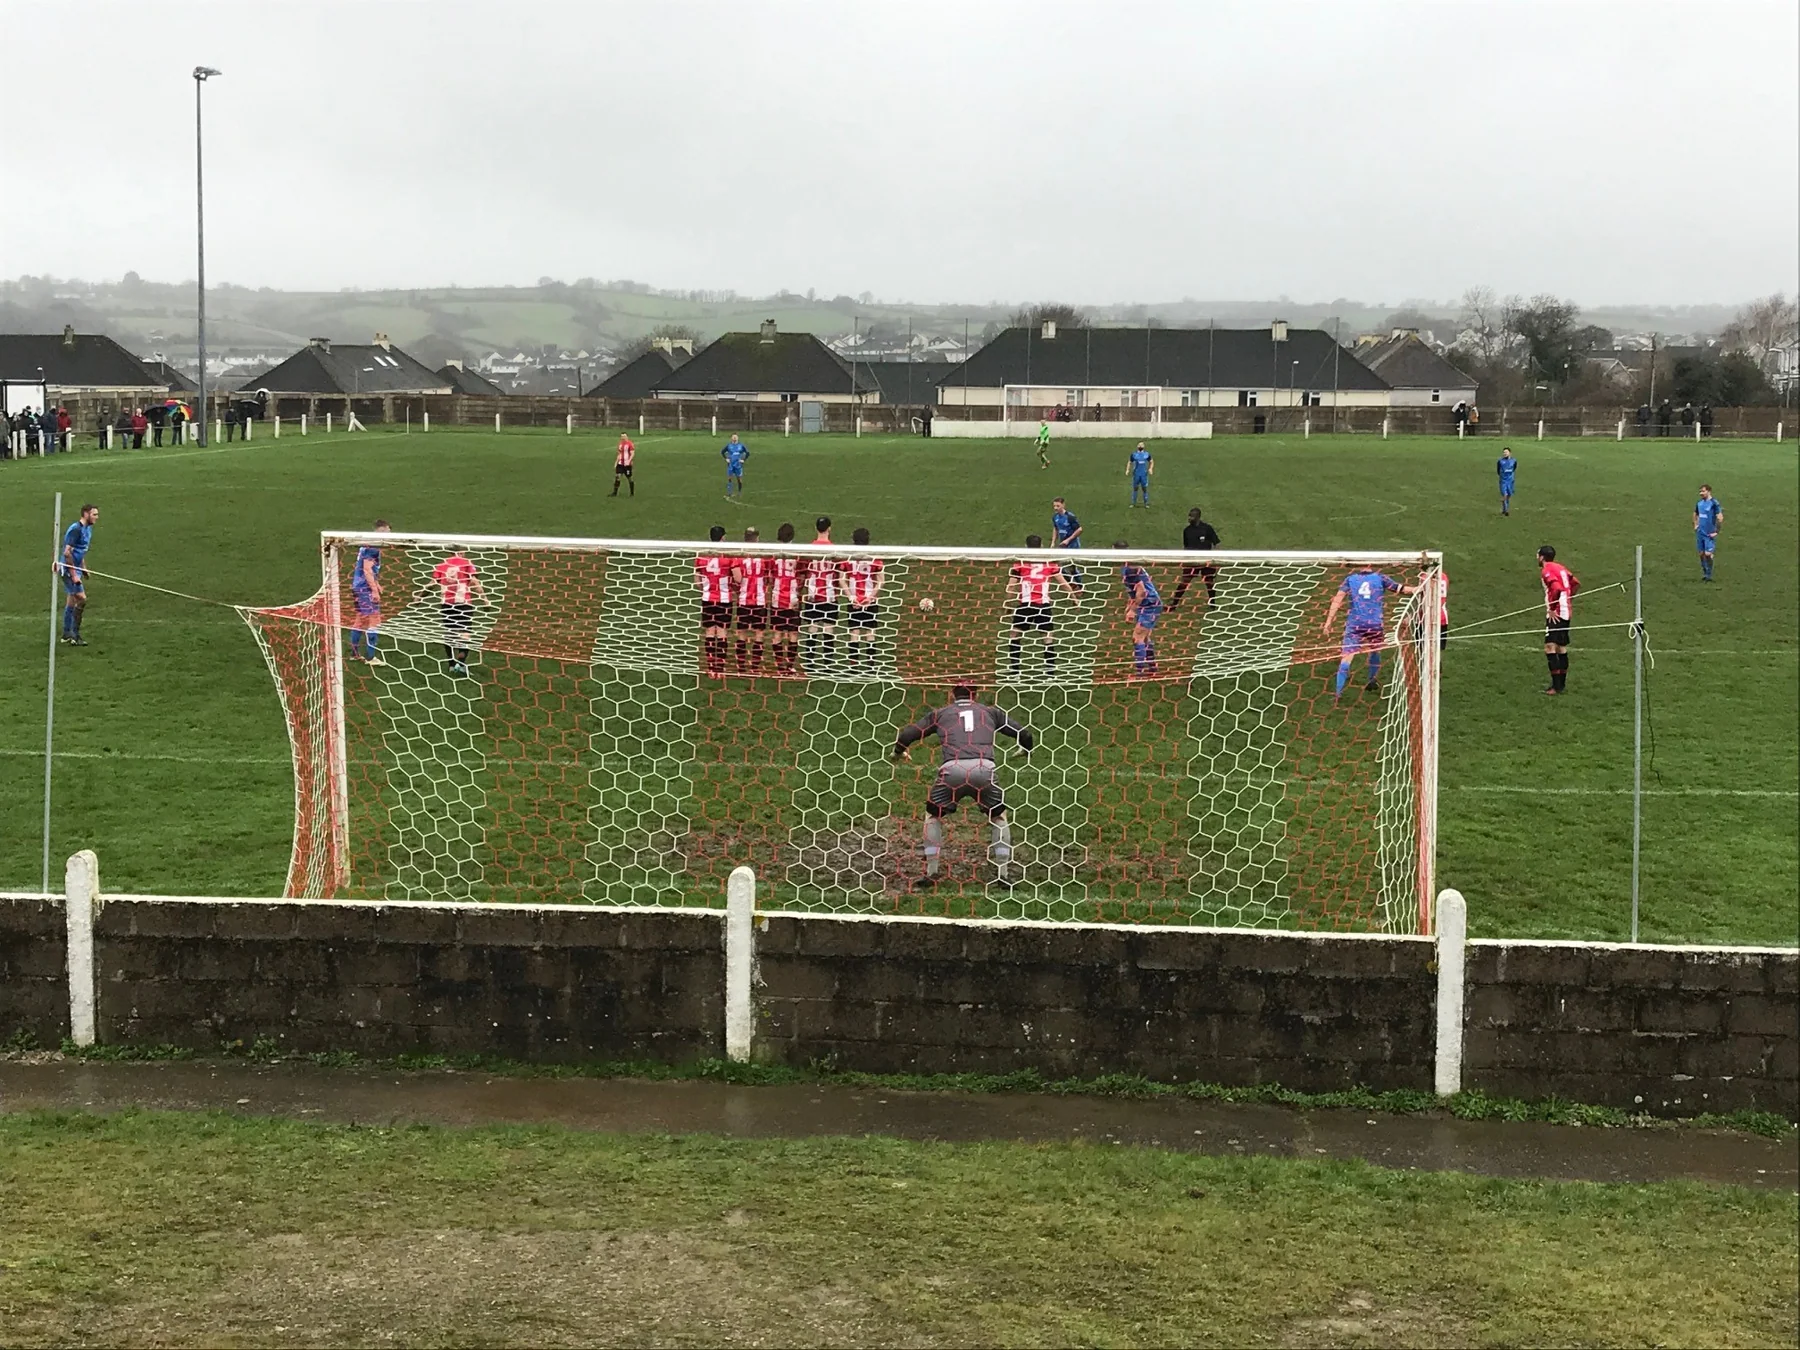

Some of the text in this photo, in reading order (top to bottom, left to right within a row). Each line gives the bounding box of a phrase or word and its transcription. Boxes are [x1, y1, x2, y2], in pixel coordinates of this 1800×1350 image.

[706, 557, 721, 576] 4
[742, 557, 761, 575] 11
[1030, 563, 1044, 579] 2
[1358, 581, 1371, 599] 4
[959, 710, 974, 732] 1
